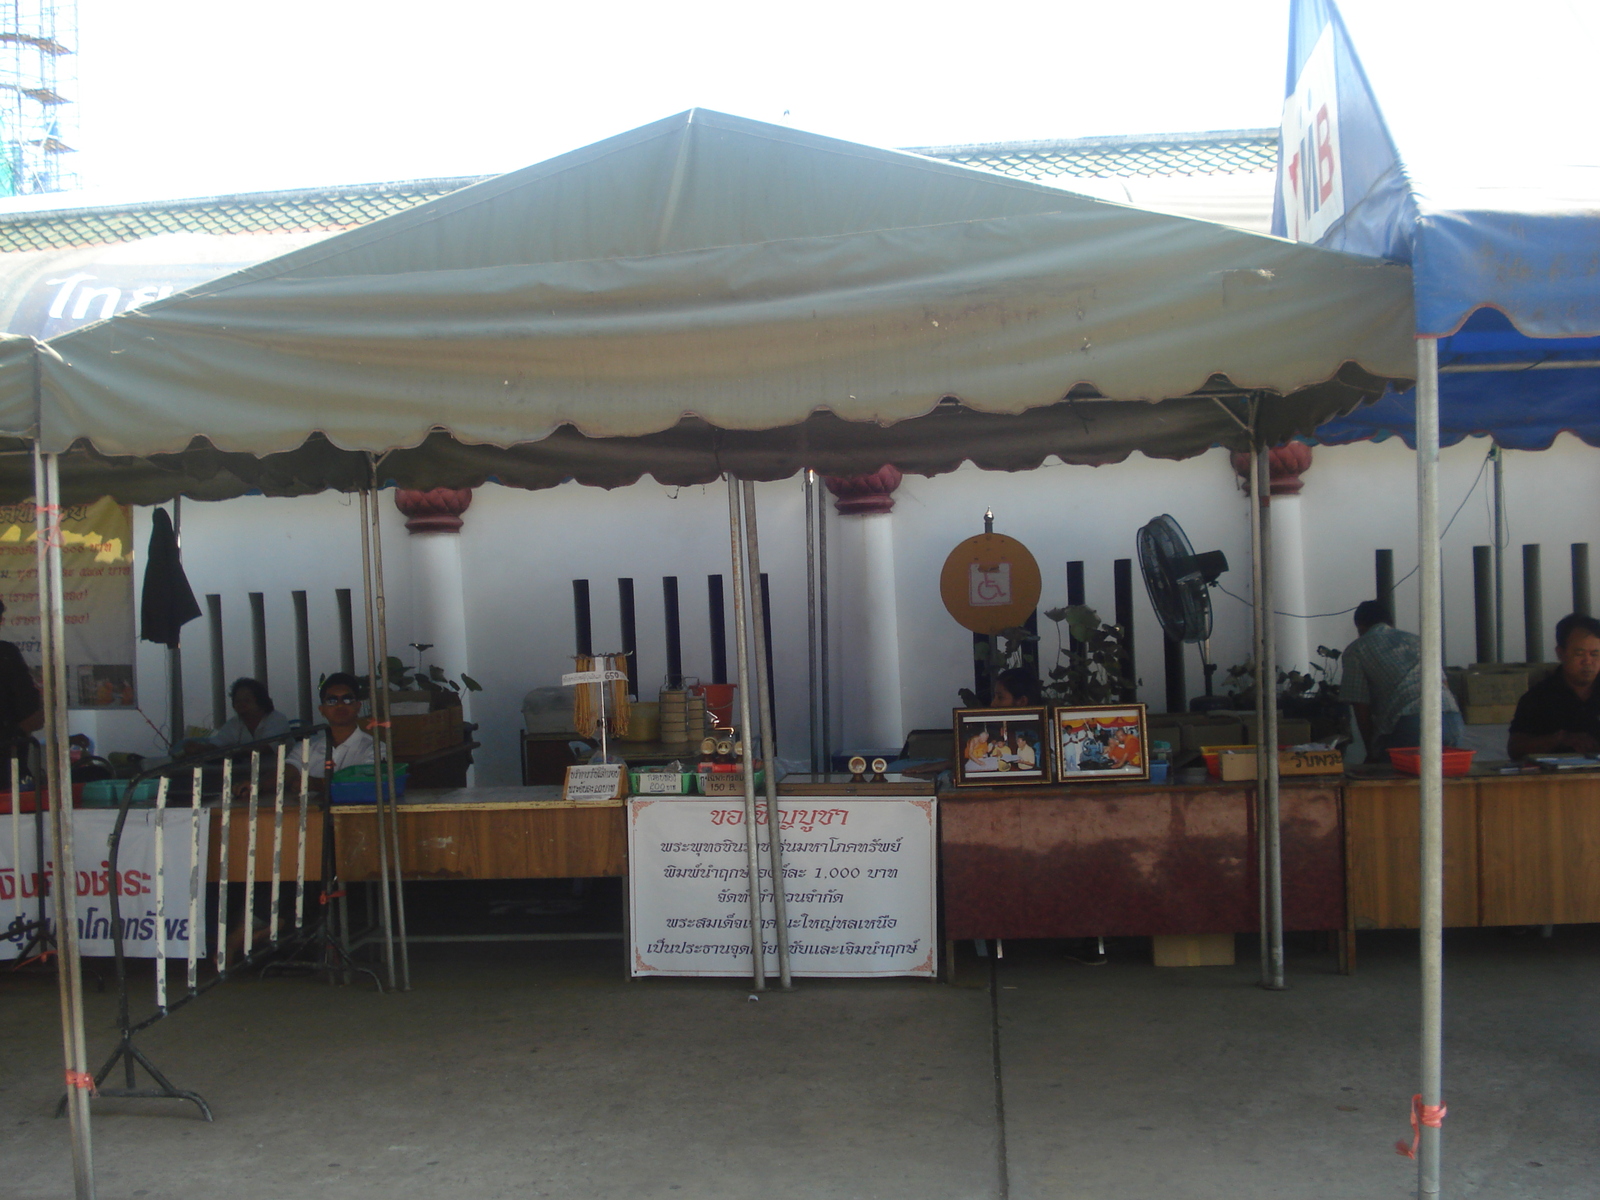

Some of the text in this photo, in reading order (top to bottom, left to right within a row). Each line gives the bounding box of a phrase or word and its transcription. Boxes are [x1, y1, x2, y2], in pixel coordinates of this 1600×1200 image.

[710, 783, 725, 792] 150
[710, 804, 849, 832] ขอชิญบูชา
[867, 867, 899, 879] บาท
[717, 888, 844, 904] จัดทจำวนจำกัด
